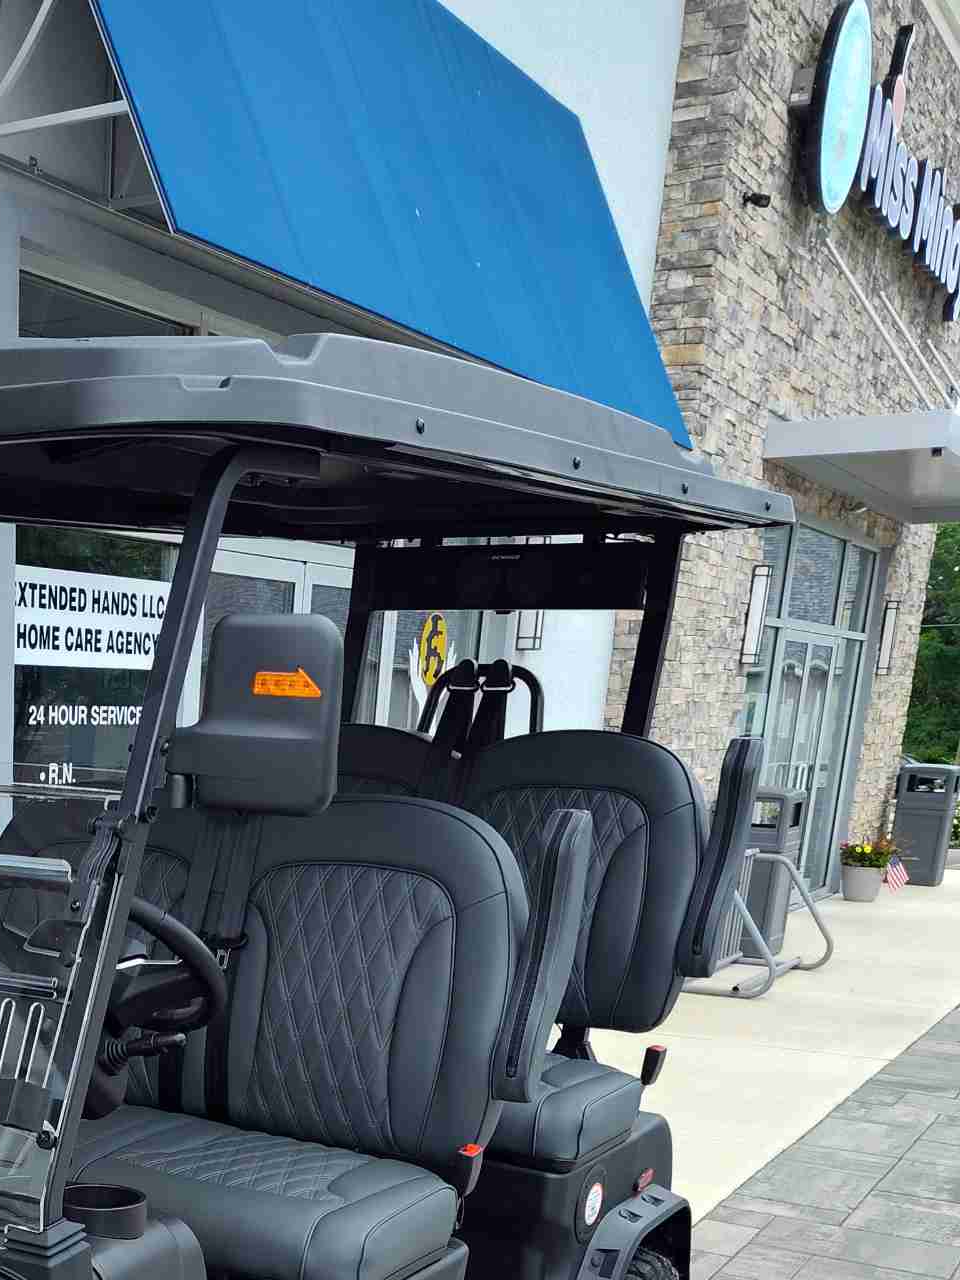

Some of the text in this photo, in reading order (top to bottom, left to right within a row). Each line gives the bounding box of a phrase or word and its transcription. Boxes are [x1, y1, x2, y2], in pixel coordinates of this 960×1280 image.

[15, 581, 165, 620] XTENDED HANDS LLC
[16, 623, 160, 656] HOME CARE AGENCY
[28, 704, 46, 726] 24
[48, 704, 88, 726] HOUR
[48, 762, 77, 785] R.N.
